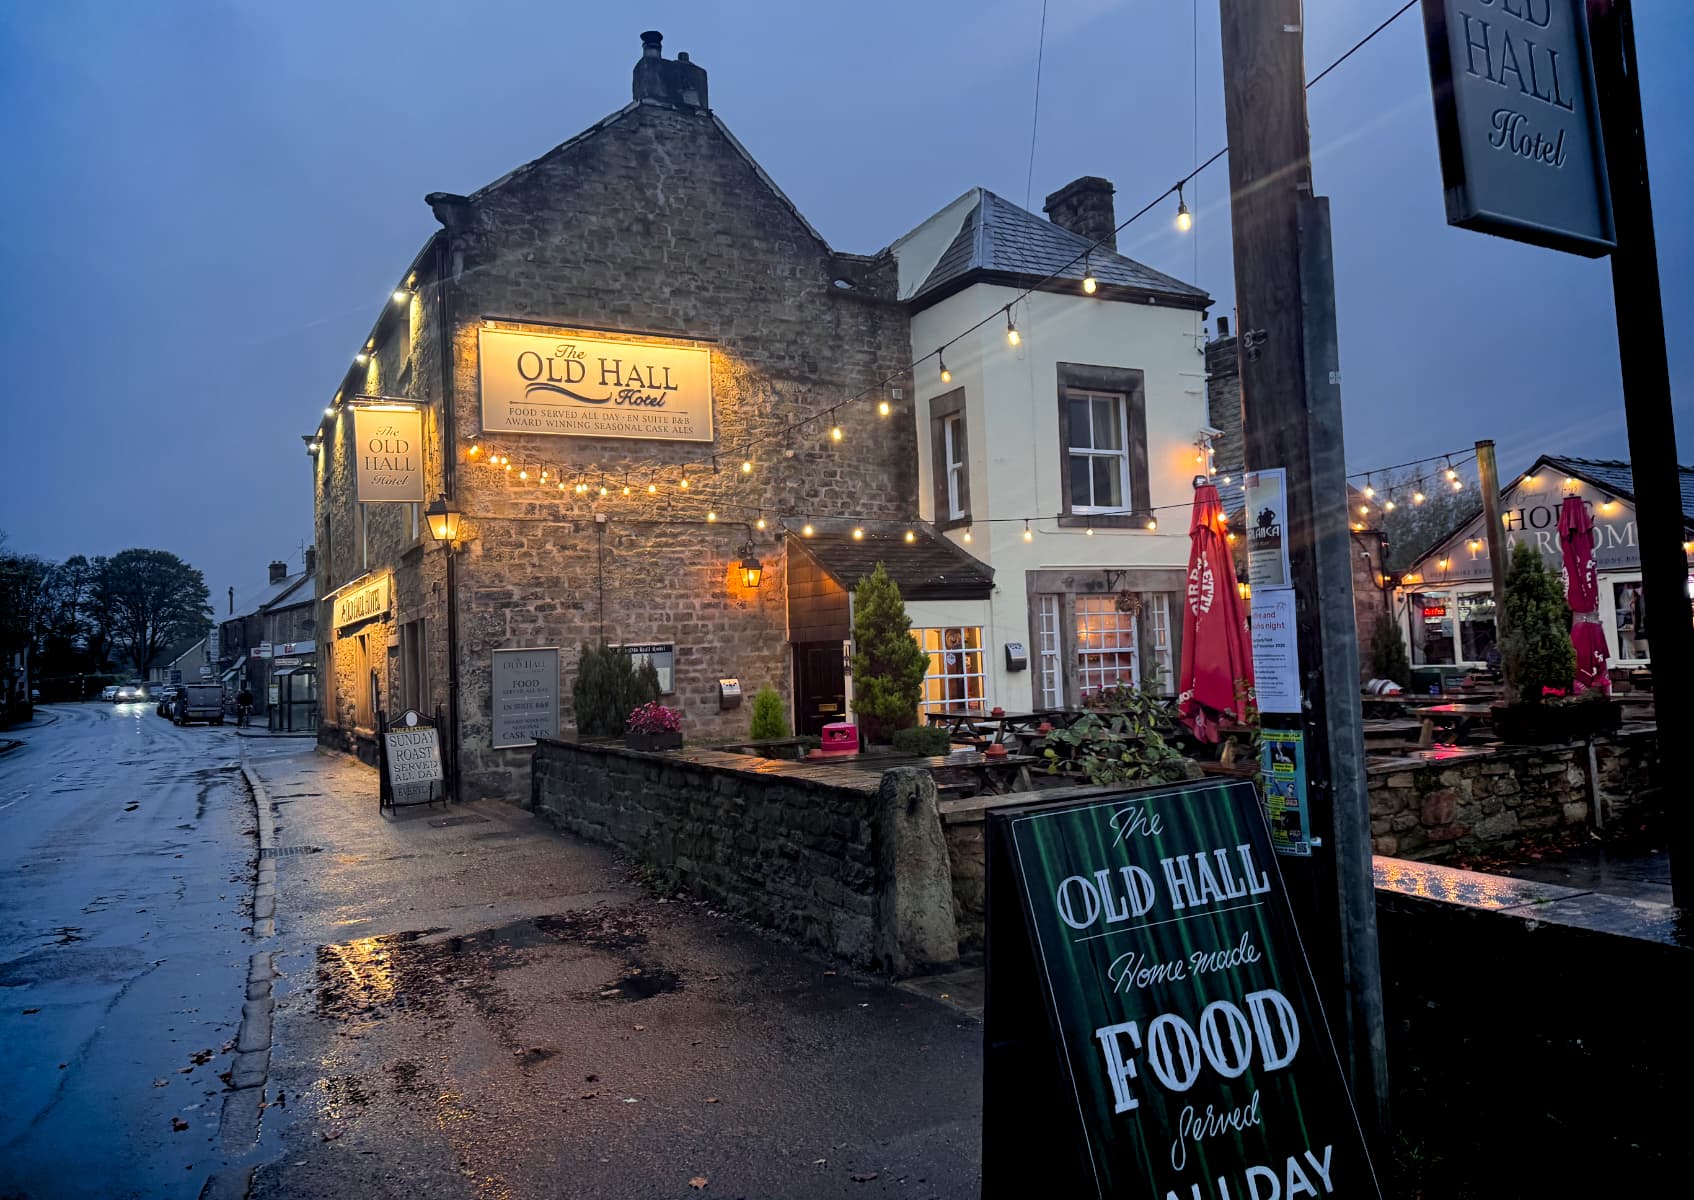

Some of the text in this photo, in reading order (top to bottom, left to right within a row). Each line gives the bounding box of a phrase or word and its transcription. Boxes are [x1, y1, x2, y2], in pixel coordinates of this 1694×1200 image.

[1459, 10, 1575, 113] HALL
[1488, 108, 1567, 168] Hotel
[555, 344, 586, 360] The
[517, 351, 678, 391] OLD HALL
[614, 388, 667, 407] Hotel
[509, 407, 690, 424] FOOD SERVED ALL DAY EN SUITE B&B
[376, 426, 399, 437] The
[506, 417, 694, 434] AWARD WINNING SEASONAL CASK ALES
[369, 438, 409, 454] OLD
[366, 456, 416, 472] HALL
[371, 474, 408, 486] Hotel
[1506, 501, 1595, 532] HO
[512, 680, 540, 688] FOOD
[390, 732, 434, 748] SUNDAY
[396, 746, 432, 762] ROAST
[394, 760, 438, 772] SERVED
[395, 768, 438, 782] ALL DAY
[1109, 805, 1164, 848] The
[1056, 843, 1272, 930] OLD HALL
[1107, 930, 1261, 994] Home-made
[1095, 988, 1300, 1115] FOOD
[1171, 1089, 1261, 1171] Served
[1245, 1144, 1334, 1200] DAY
